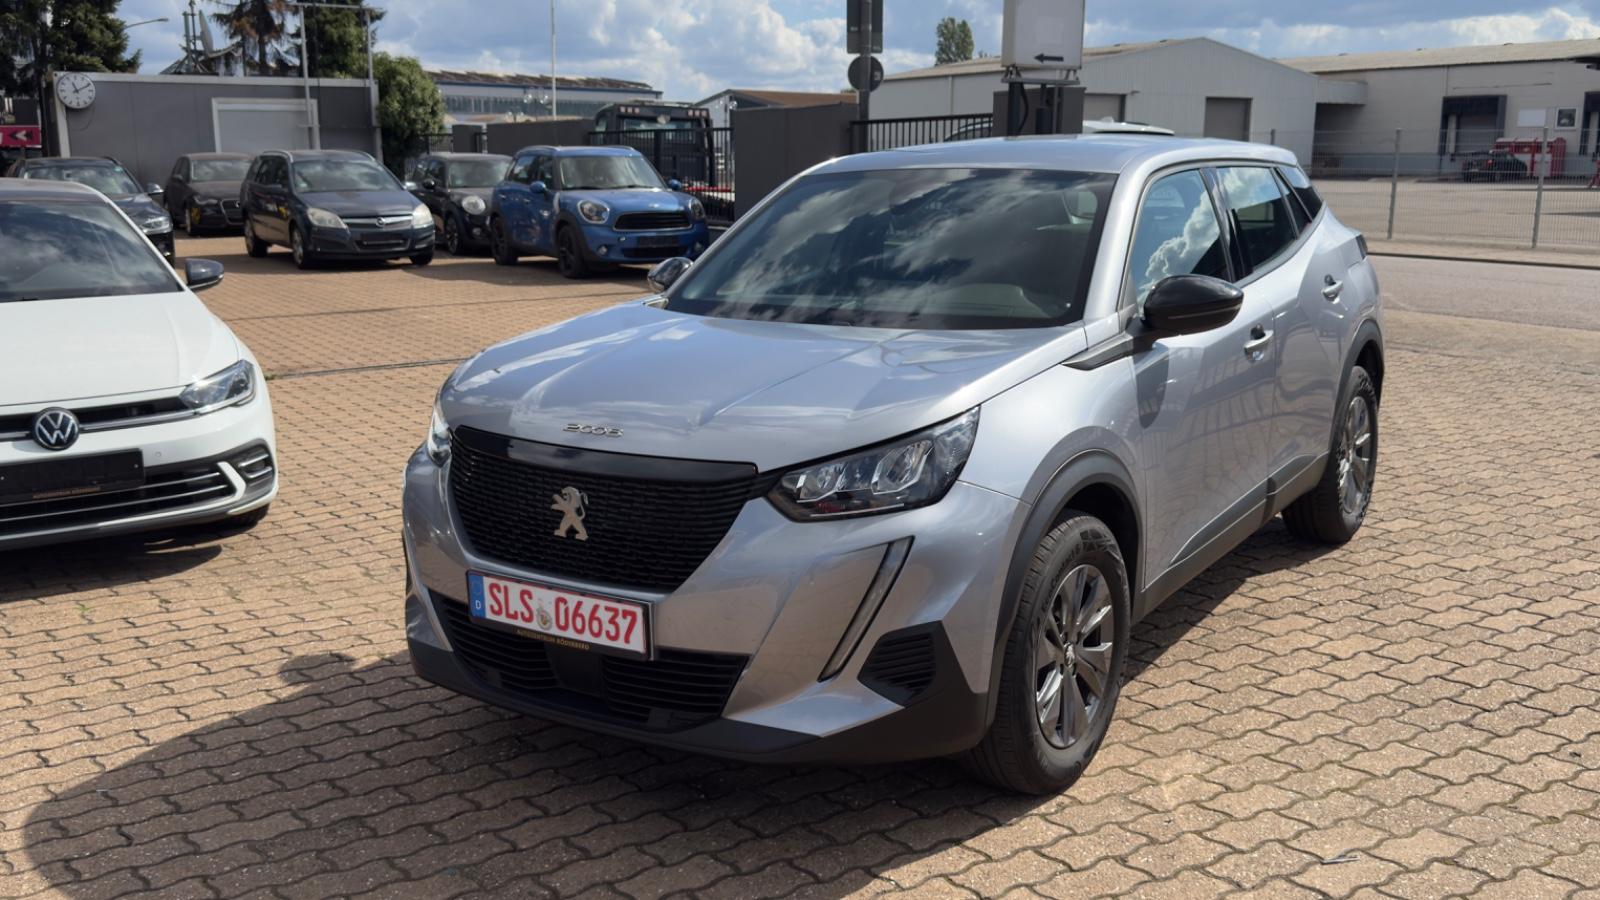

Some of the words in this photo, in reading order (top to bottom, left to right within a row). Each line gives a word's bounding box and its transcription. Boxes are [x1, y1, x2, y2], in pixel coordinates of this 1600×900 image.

[563, 423, 624, 438] 2008
[475, 600, 482, 610] D
[488, 582, 535, 623] SLS
[554, 596, 638, 644] 06637
